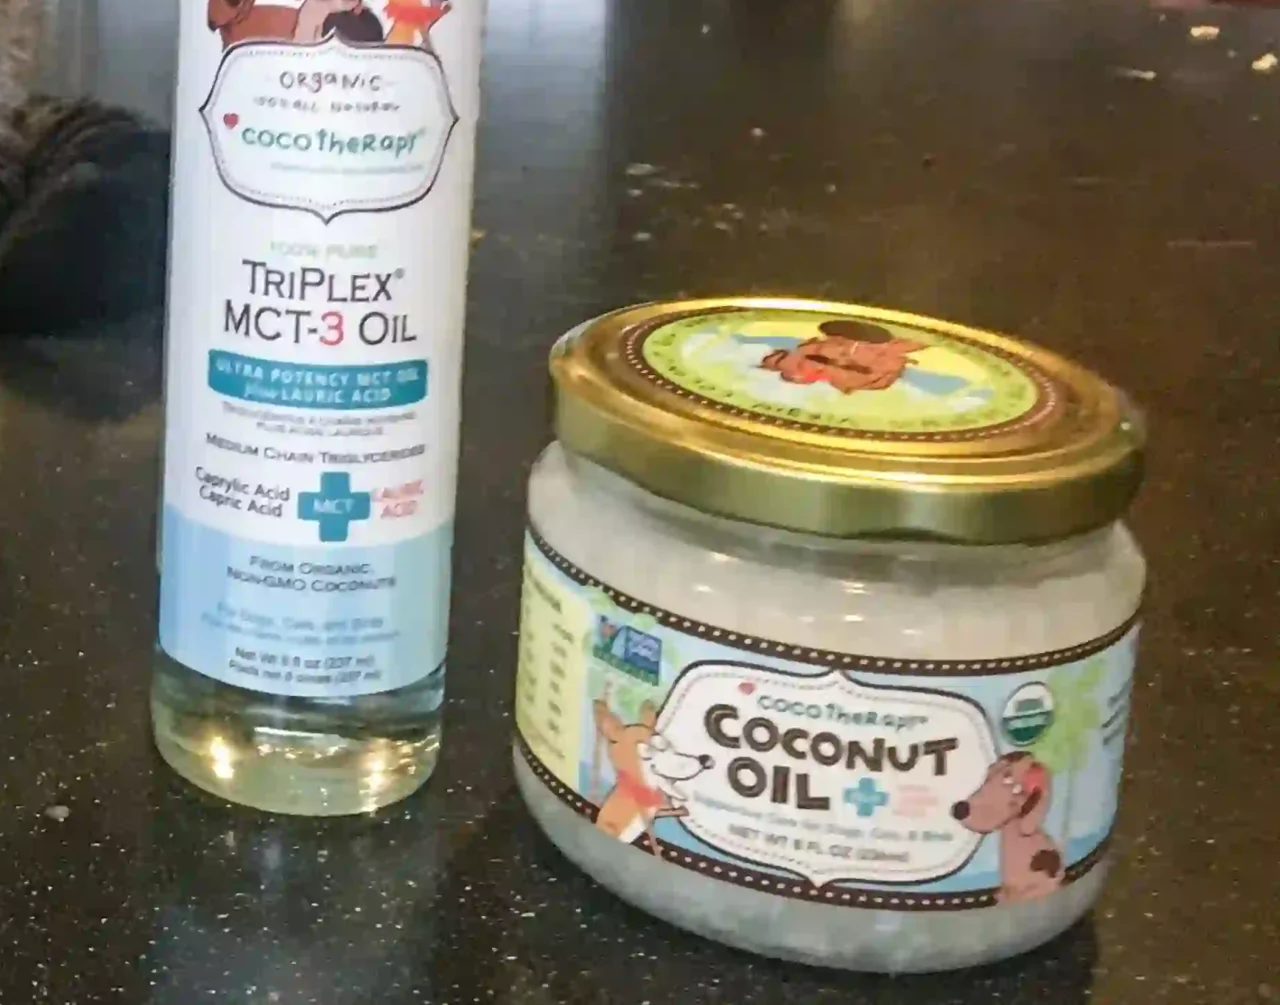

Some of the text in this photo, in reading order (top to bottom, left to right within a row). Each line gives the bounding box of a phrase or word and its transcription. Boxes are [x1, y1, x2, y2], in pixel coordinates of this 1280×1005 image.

[224, 299, 344, 346] MCT-3
[216, 357, 263, 380] ULTRA
[271, 367, 350, 387] POTENCY
[357, 371, 391, 386] MCT
[281, 387, 345, 403] LAURIC
[352, 387, 392, 403] ACID
[195, 467, 290, 501] Caprylic Acid
[199, 485, 283, 518] Capric Acid
[704, 703, 959, 776] COCONUT
[727, 756, 830, 810] OIL
